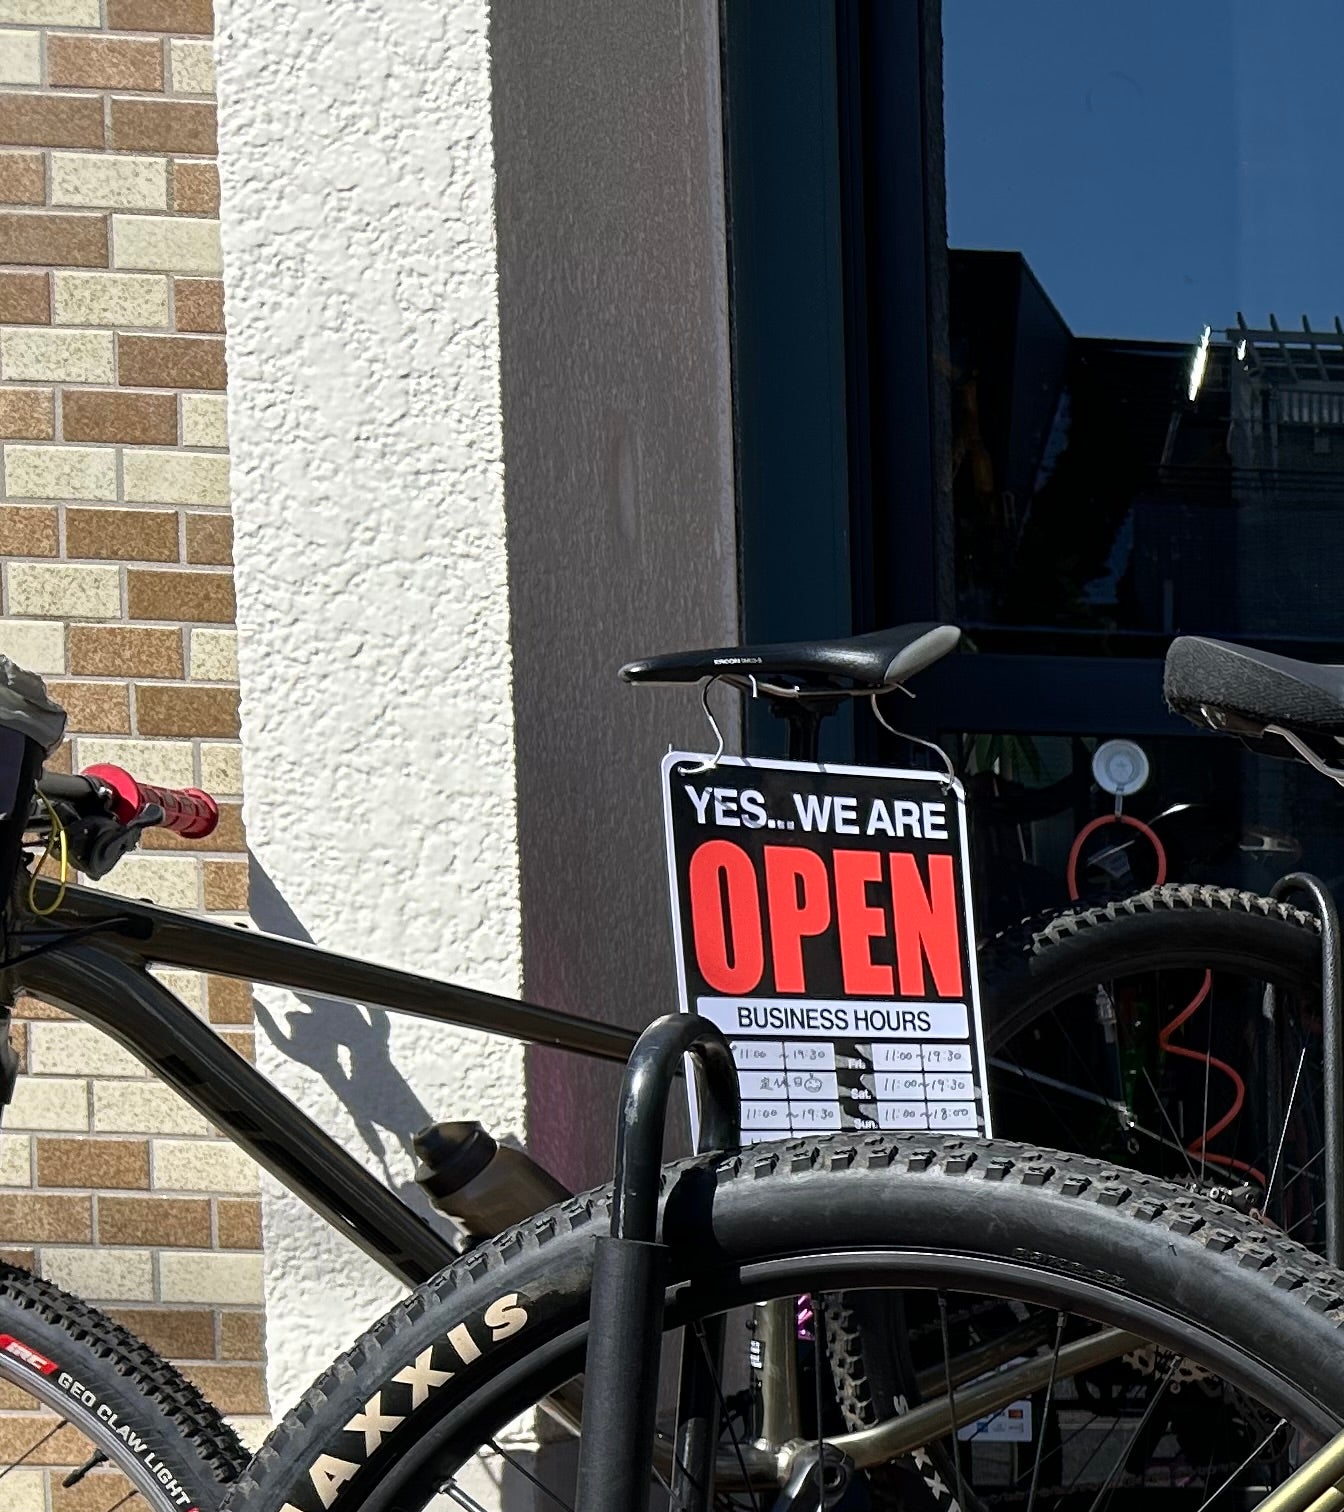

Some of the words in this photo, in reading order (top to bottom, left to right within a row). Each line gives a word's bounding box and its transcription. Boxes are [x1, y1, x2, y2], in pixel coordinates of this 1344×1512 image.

[867, 800, 948, 840] ARE
[688, 839, 965, 998] OPEN
[737, 1006, 850, 1030] BUSINESS
[854, 1009, 932, 1032] HOURS
[57, 1371, 97, 1408] GEO
[95, 1402, 148, 1454] CLAW
[143, 1451, 192, 1506] LIGHT
